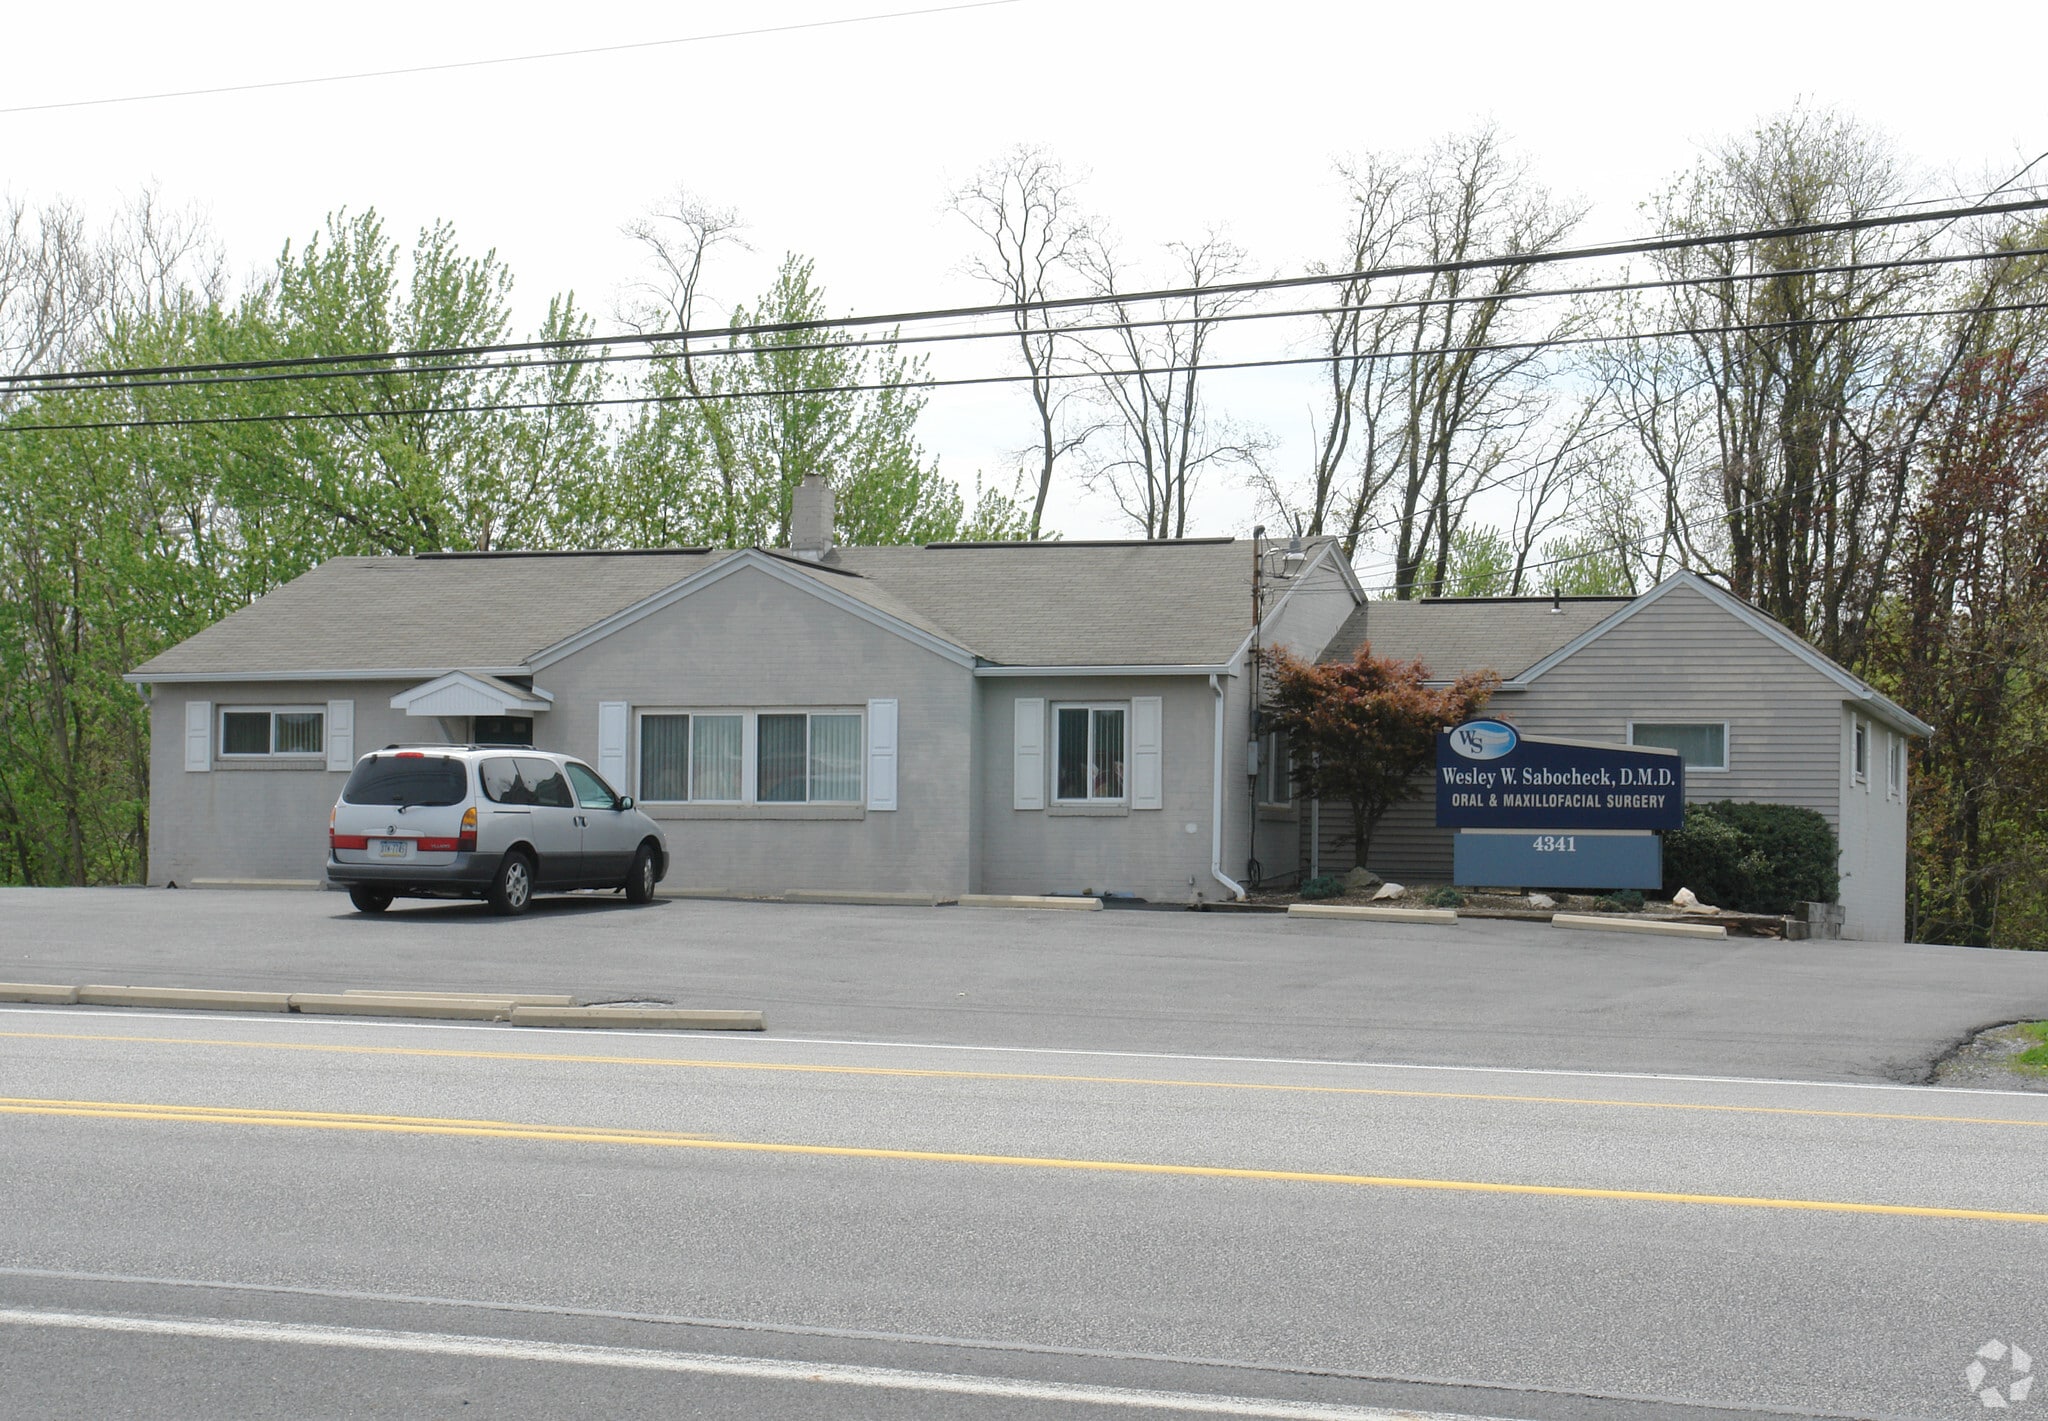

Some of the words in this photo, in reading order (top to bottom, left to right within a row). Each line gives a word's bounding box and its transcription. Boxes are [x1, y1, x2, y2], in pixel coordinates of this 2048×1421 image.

[1442, 767, 1496, 789] Wesley
[1500, 767, 1517, 785] W.
[1522, 767, 1615, 788] Sabocheck,
[1620, 768, 1676, 786] D.M.D.
[1452, 793, 1484, 807] ORAL
[1489, 794, 1498, 807] &
[1503, 793, 1601, 808] MAXILLOFACIAL
[1606, 794, 1665, 809] SURGERY
[1532, 836, 1576, 852] 4341
